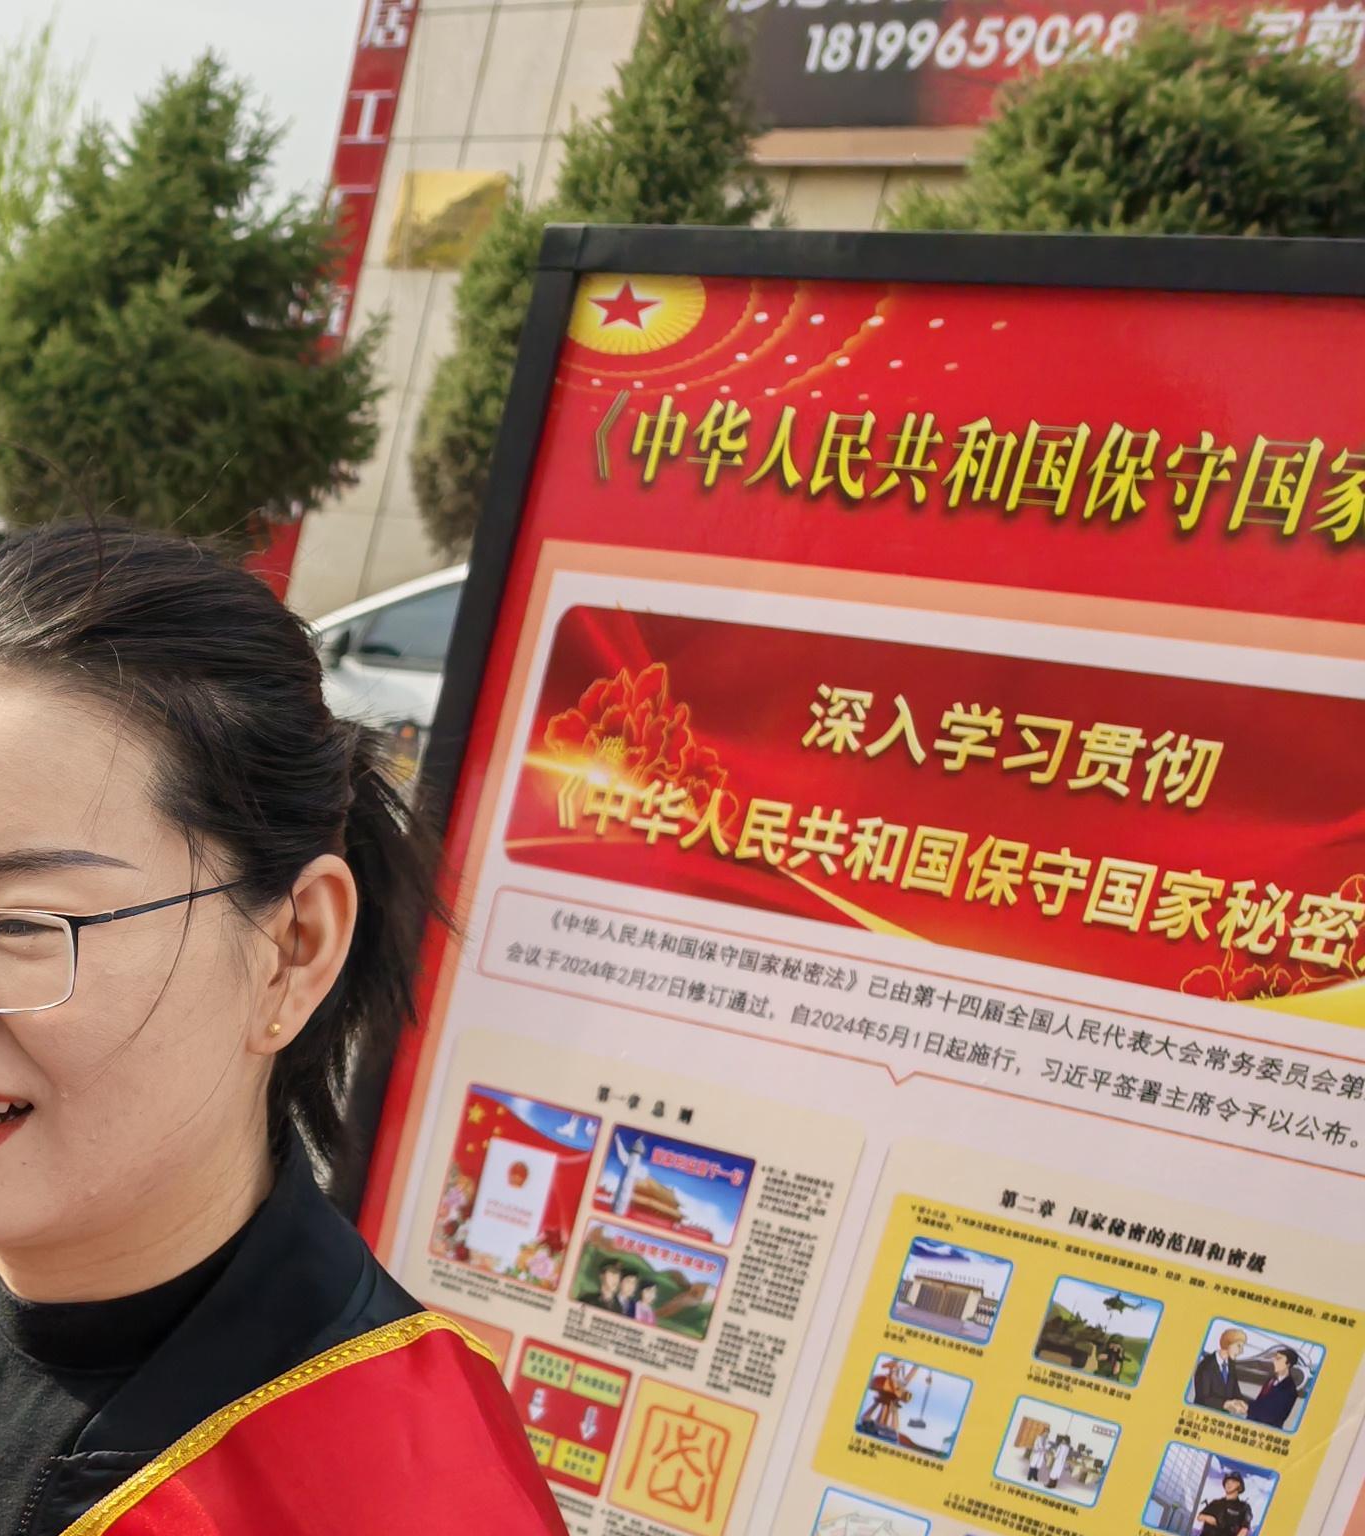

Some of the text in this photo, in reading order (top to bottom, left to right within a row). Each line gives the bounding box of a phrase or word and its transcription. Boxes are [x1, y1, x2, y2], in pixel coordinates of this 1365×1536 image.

[801, 683, 1224, 809] 深入学习贯彻
[556, 773, 1365, 972] 《中华人民共和国保守国家秘密
[998, 1188, 1057, 1219] 第二章
[1068, 1205, 1268, 1274] 国家秘密的范围和密级
